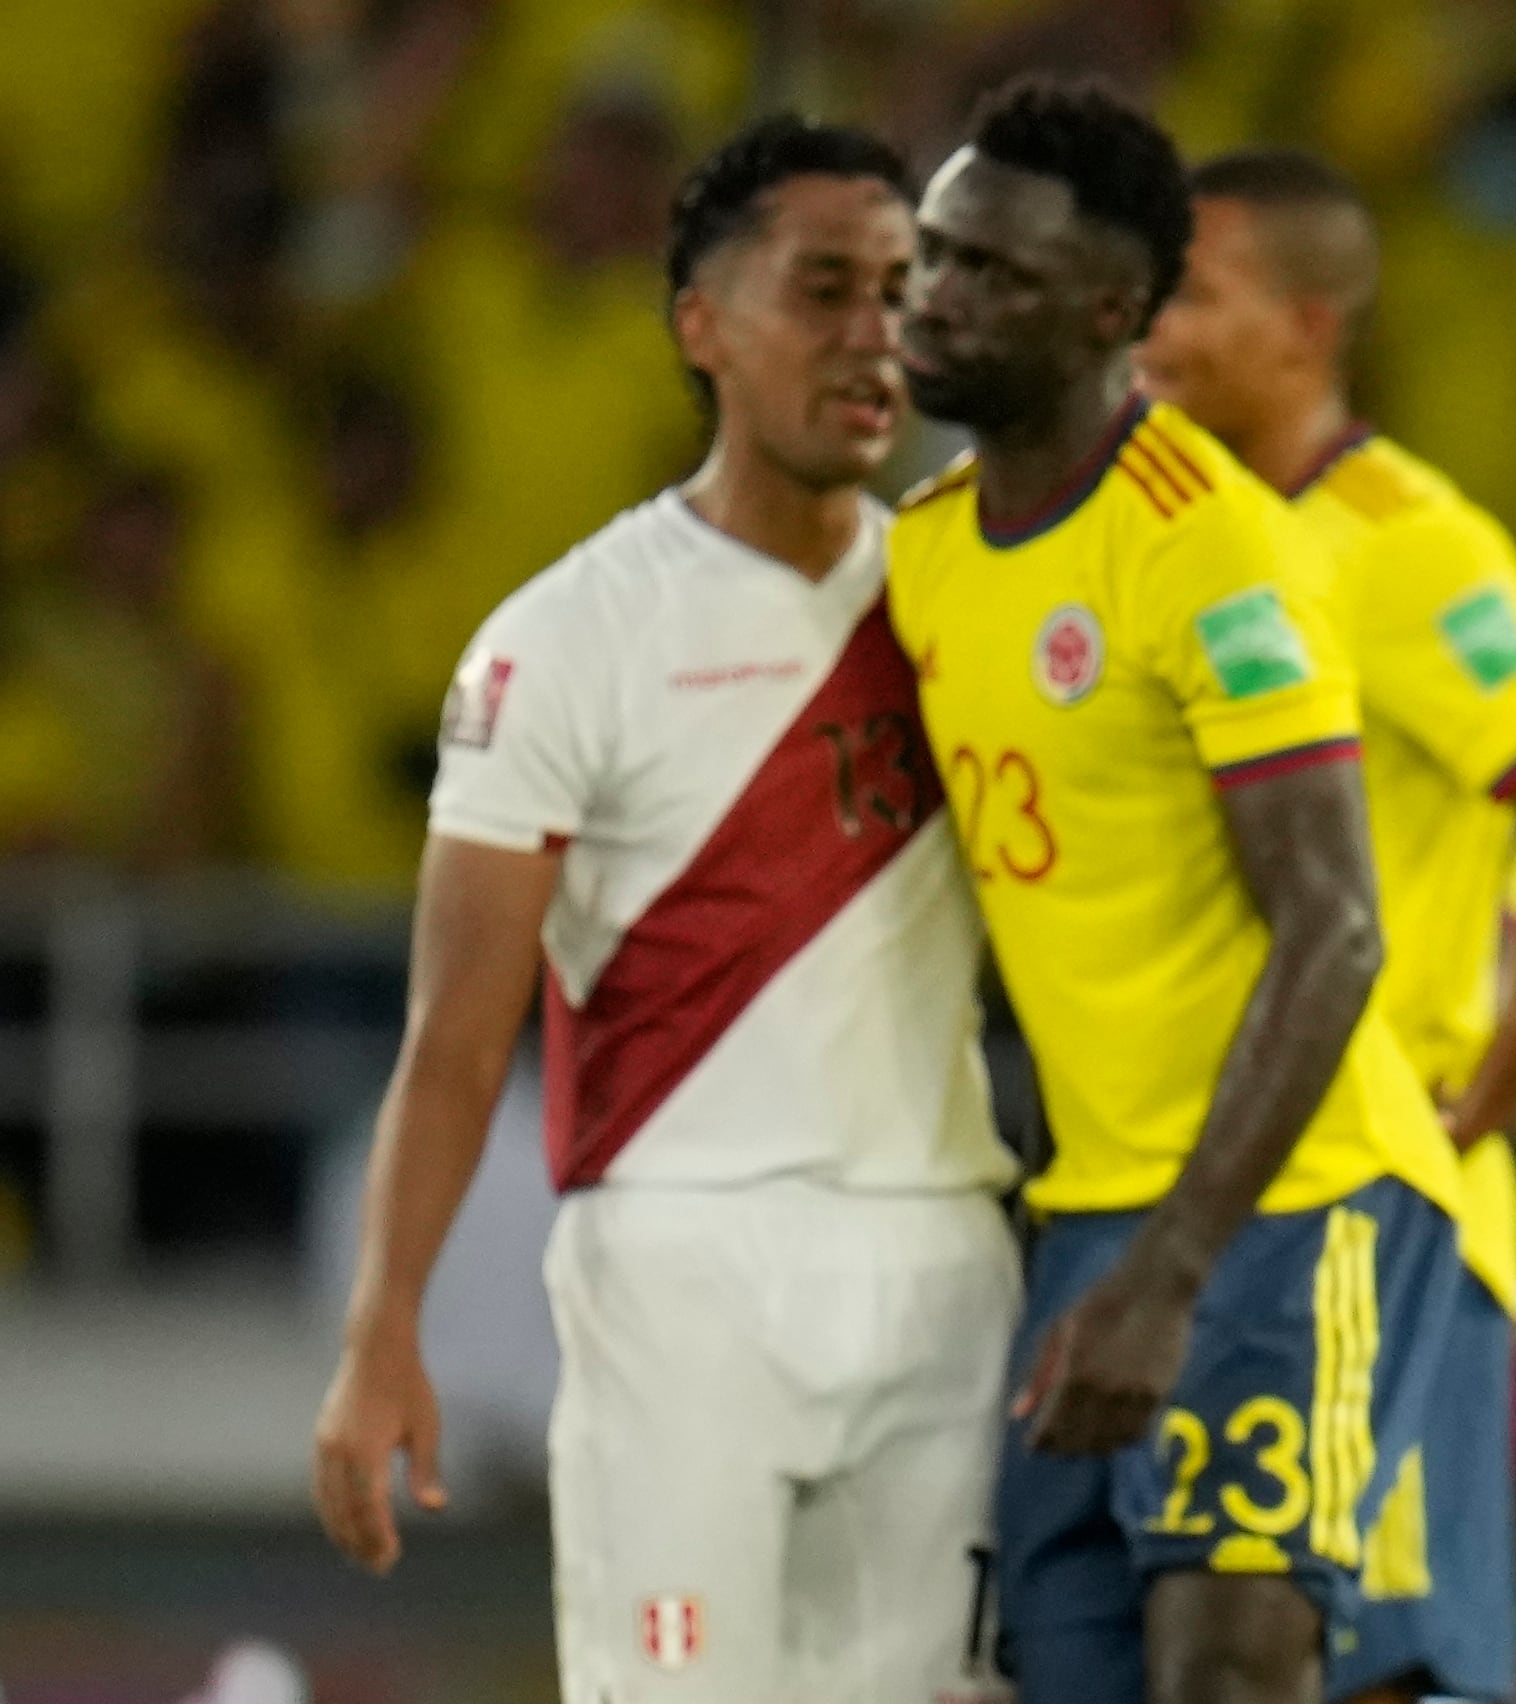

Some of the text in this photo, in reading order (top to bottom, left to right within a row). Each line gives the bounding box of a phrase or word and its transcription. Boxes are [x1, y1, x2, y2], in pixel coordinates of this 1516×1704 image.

[811, 712, 930, 836] 13
[946, 742, 1059, 883] 23
[1143, 1394, 1312, 1537] 23
